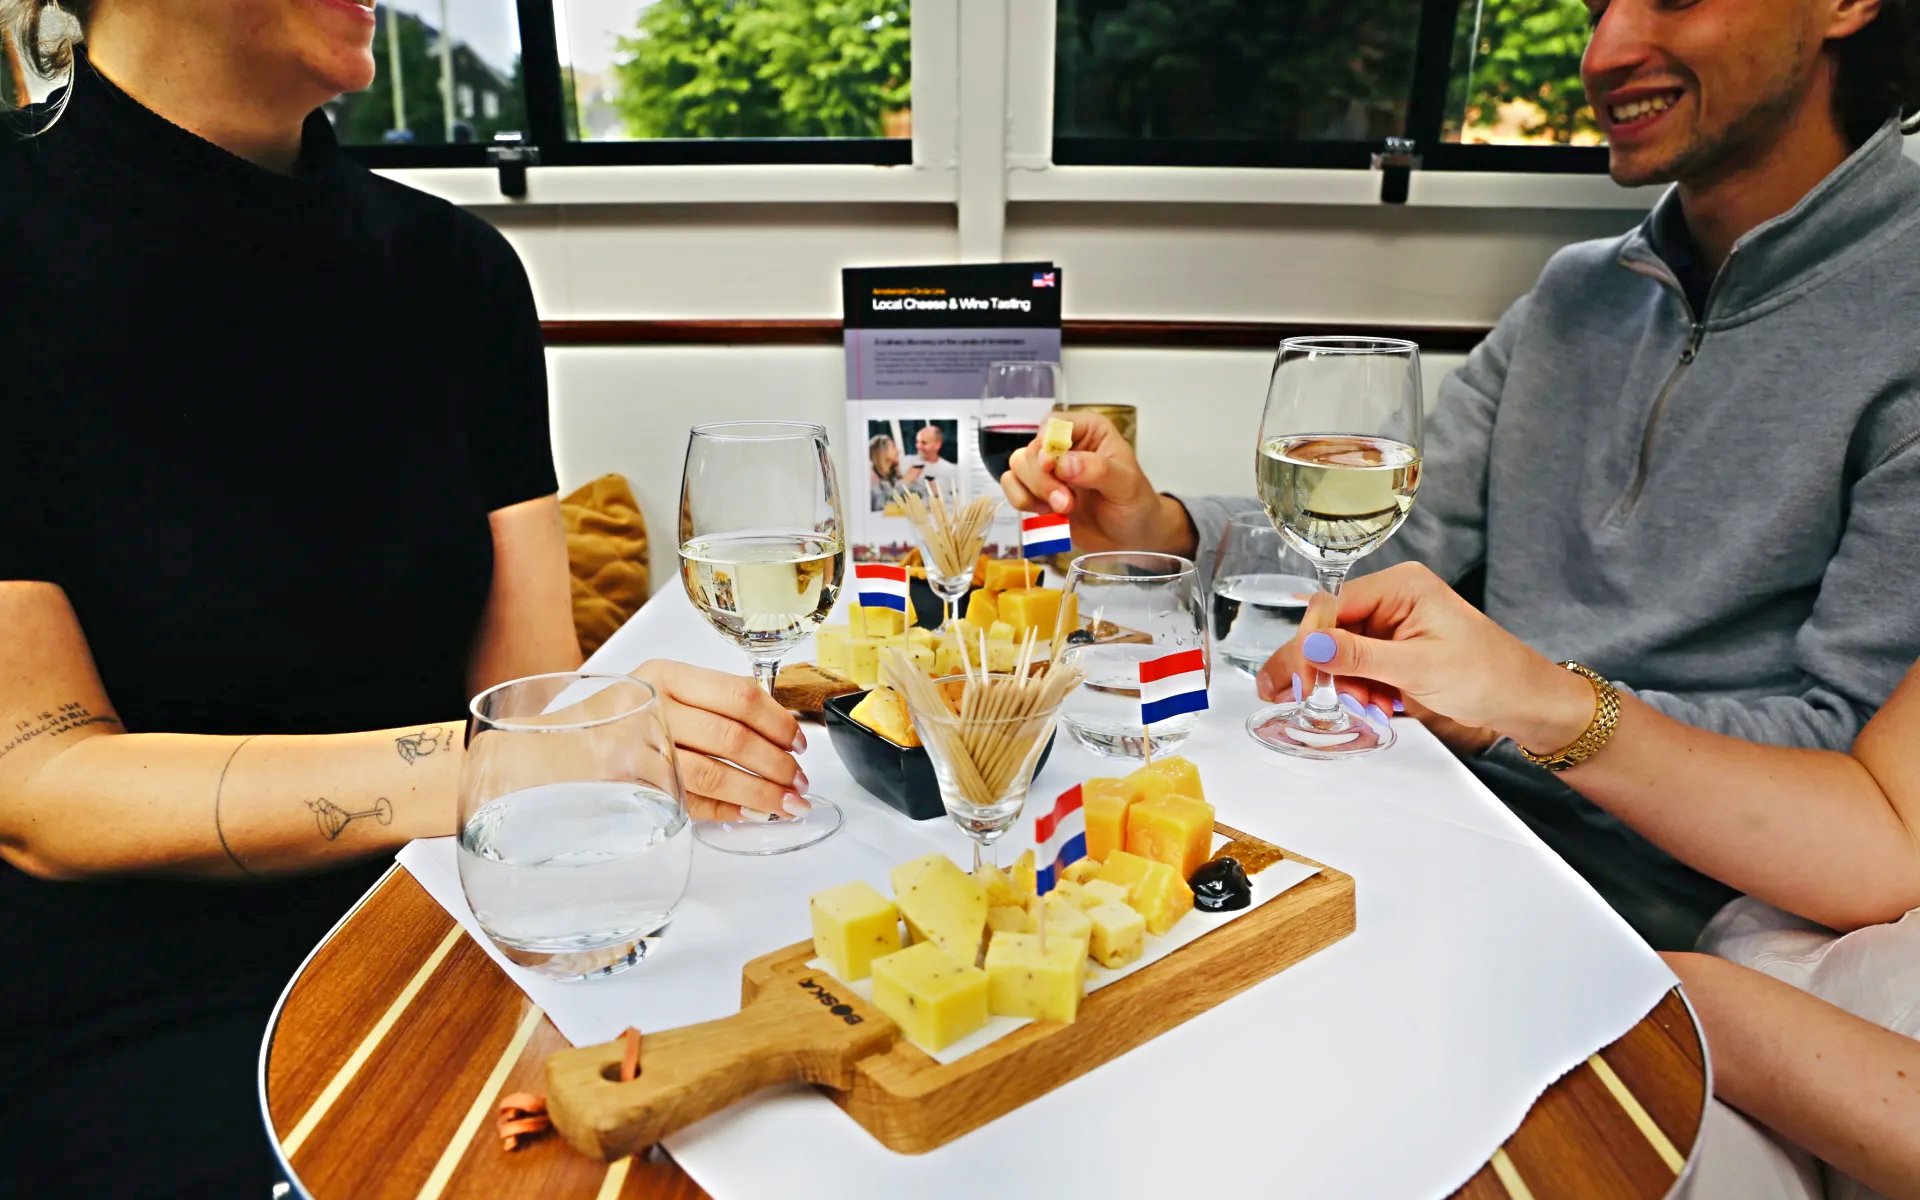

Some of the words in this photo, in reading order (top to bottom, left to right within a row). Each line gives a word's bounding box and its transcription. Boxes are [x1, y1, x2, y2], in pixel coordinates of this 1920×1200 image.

[872, 297, 903, 311] Local
[903, 297, 948, 311] Cheese
[948, 297, 958, 311] &
[958, 297, 989, 311] Wine
[990, 297, 1032, 313] Tasting
[797, 977, 864, 1026] BOSKA
